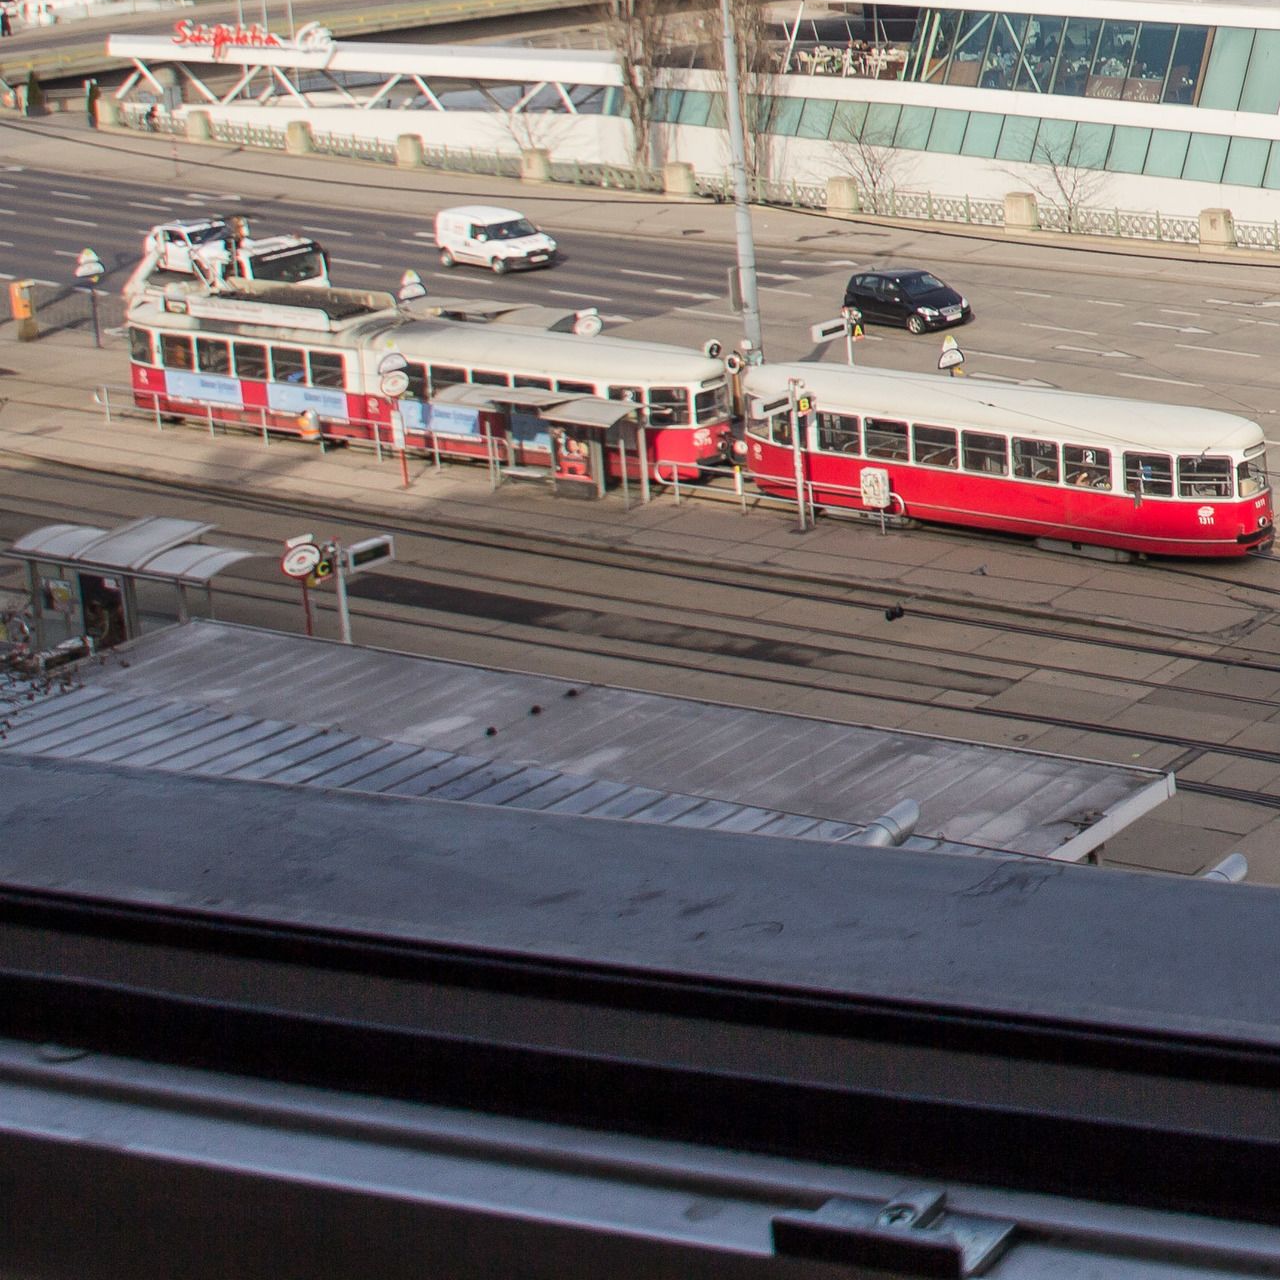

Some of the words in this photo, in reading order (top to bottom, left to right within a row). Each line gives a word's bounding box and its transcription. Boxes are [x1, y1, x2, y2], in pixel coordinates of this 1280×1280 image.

[854, 324, 863, 337] A
[799, 397, 809, 411] B
[1086, 450, 1094, 464] 2
[1199, 517, 1215, 525] 1311
[317, 560, 330, 576] C
